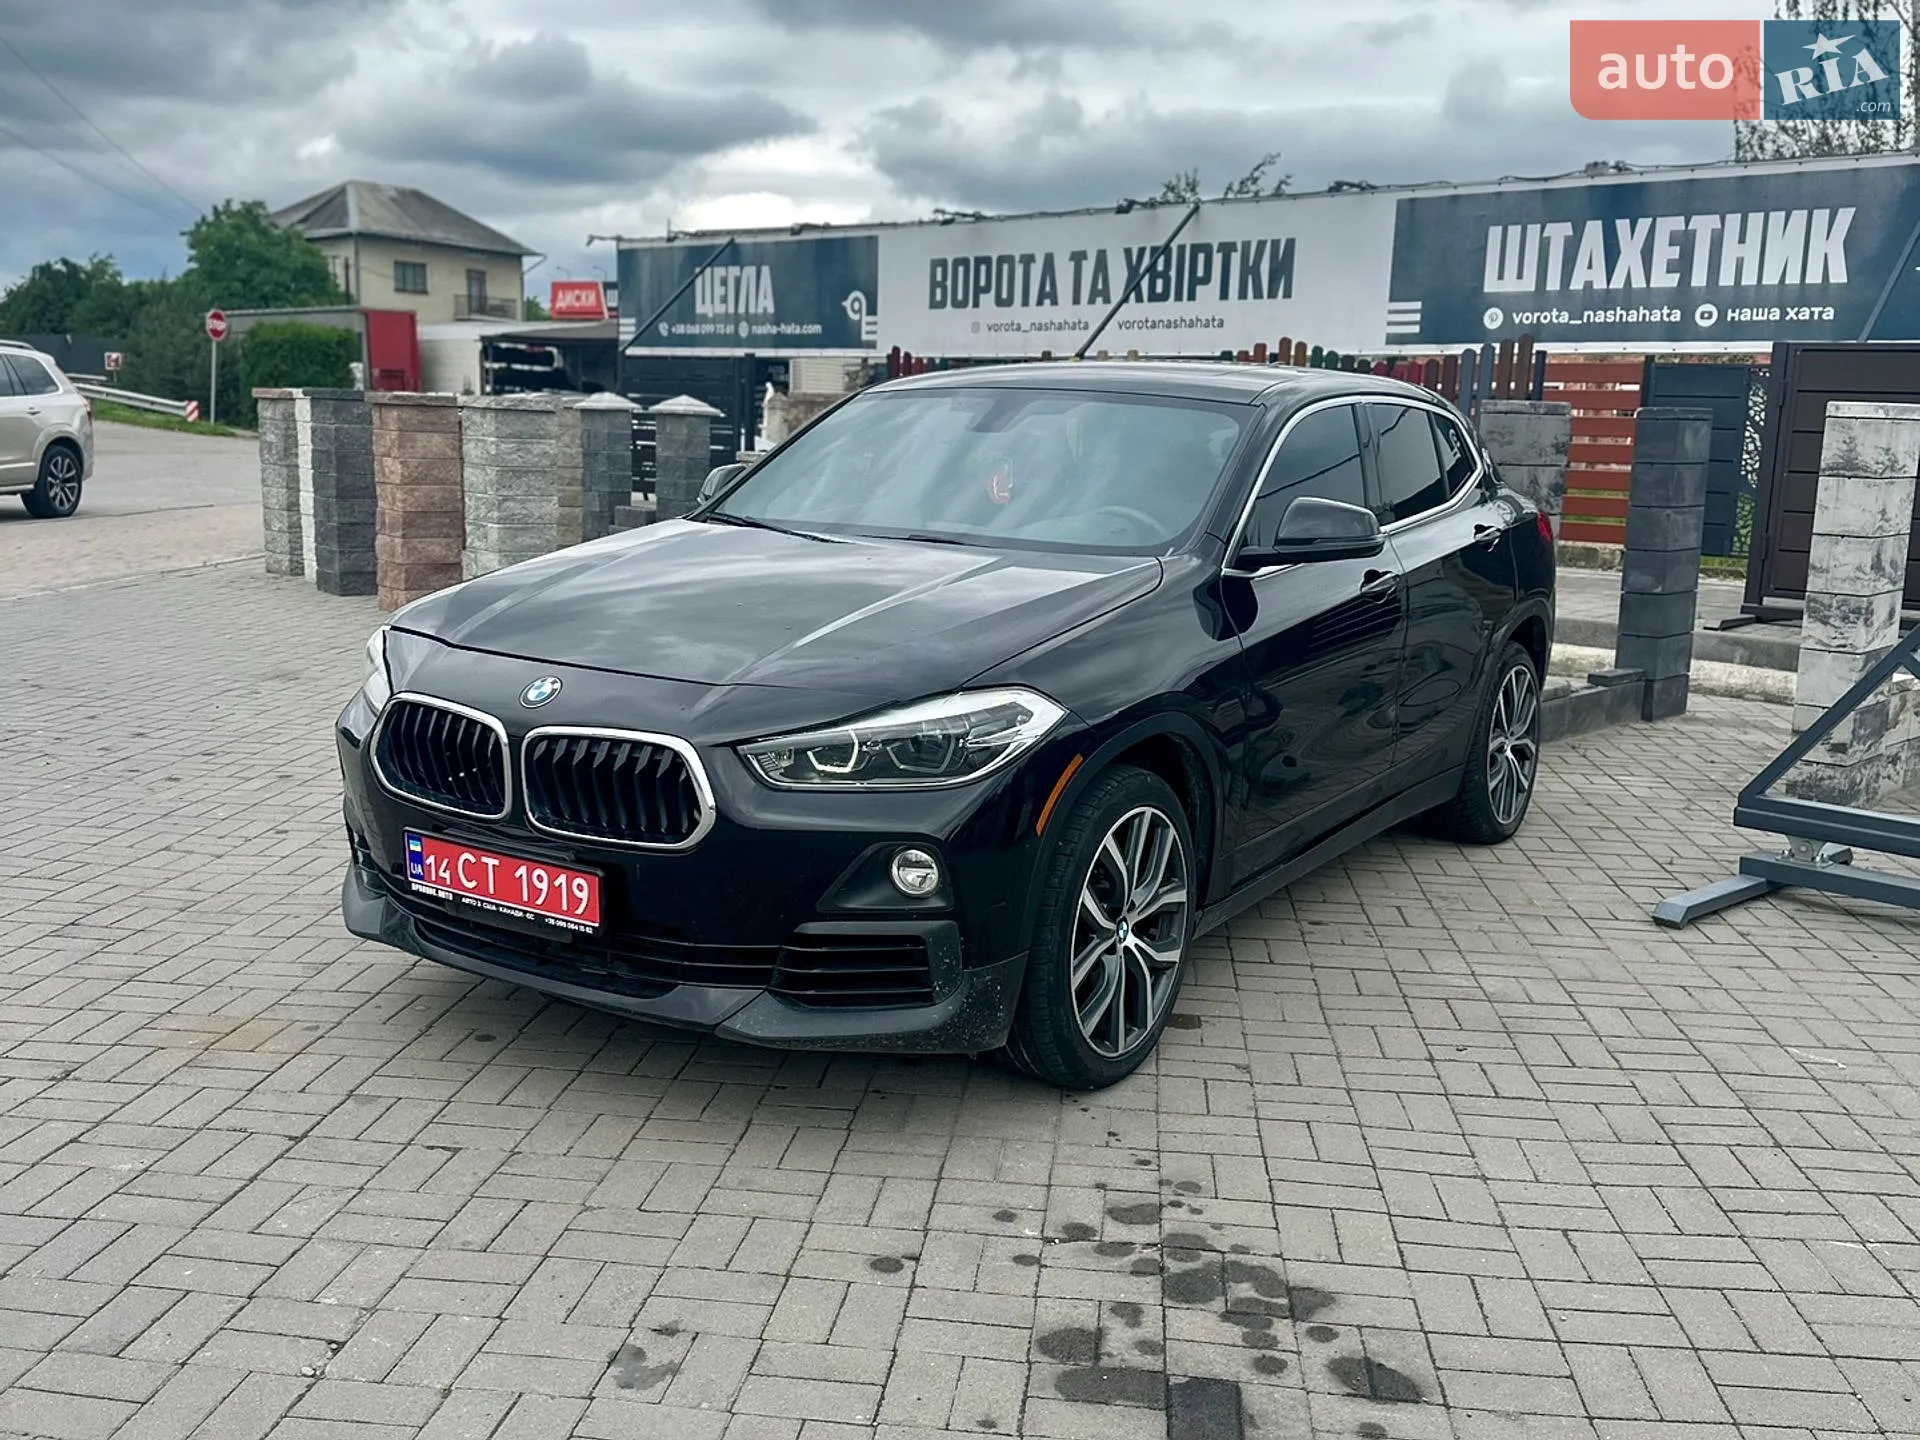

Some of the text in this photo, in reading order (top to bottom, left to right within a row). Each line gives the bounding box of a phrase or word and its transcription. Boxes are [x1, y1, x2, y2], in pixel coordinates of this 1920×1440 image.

[1483, 207, 1857, 293] ШТАХЕТНИК
[929, 237, 1297, 309] ВОРОТА ТА ХВІРТКИ
[555, 289, 597, 310] ДИСКИ
[695, 264, 776, 317] ЦЕГЛА
[1117, 315, 1225, 330] vorotanashahata
[1512, 306, 1682, 326] vorota_nashahata
[1726, 305, 1835, 322] наша хата
[751, 322, 823, 335] nasha-hata.com
[986, 317, 1090, 334] vorota_nashahata
[410, 862, 424, 876] UA
[425, 854, 451, 885] 14
[457, 851, 500, 895] CT
[513, 865, 590, 915] 1919
